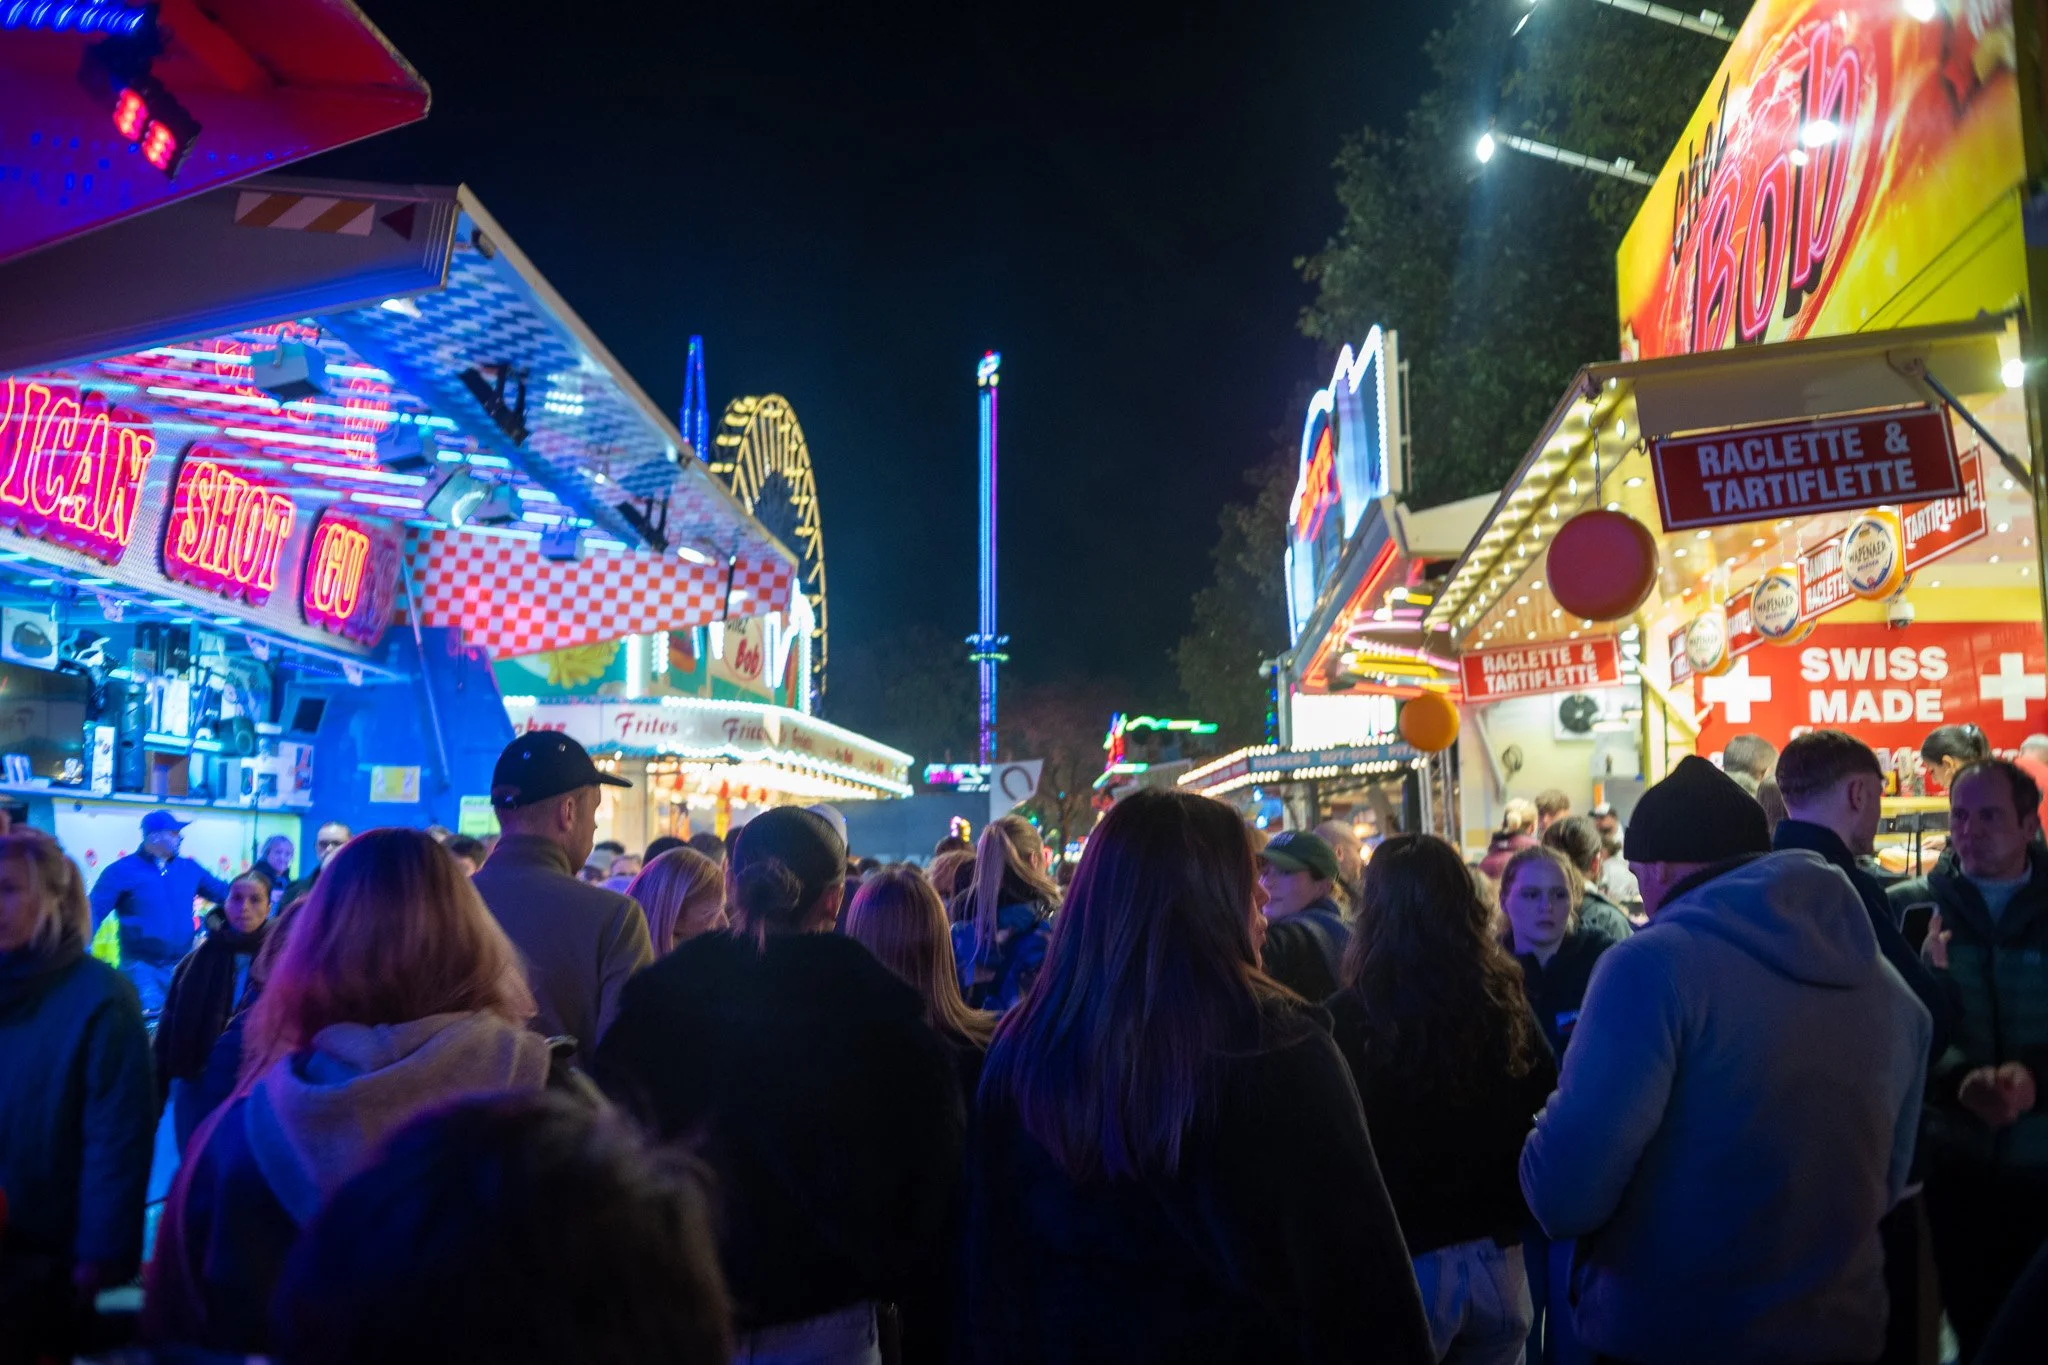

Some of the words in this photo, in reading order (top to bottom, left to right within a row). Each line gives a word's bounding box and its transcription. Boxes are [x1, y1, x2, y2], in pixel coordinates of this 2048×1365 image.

[1697, 427, 1865, 477] RACLETTE
[1884, 420, 1910, 454] &
[0, 375, 156, 546] ICAN
[177, 460, 297, 592] SHOT
[1703, 458, 1917, 513] TARTIFLETTE
[734, 637, 760, 675] Bob
[1481, 645, 1572, 674] RACLETTE
[1581, 642, 1596, 664] &
[1800, 646, 1949, 682] SWISS
[1484, 663, 1599, 694] TARTIFLETTE
[1810, 689, 1944, 723] MADE
[614, 712, 679, 738] Frites
